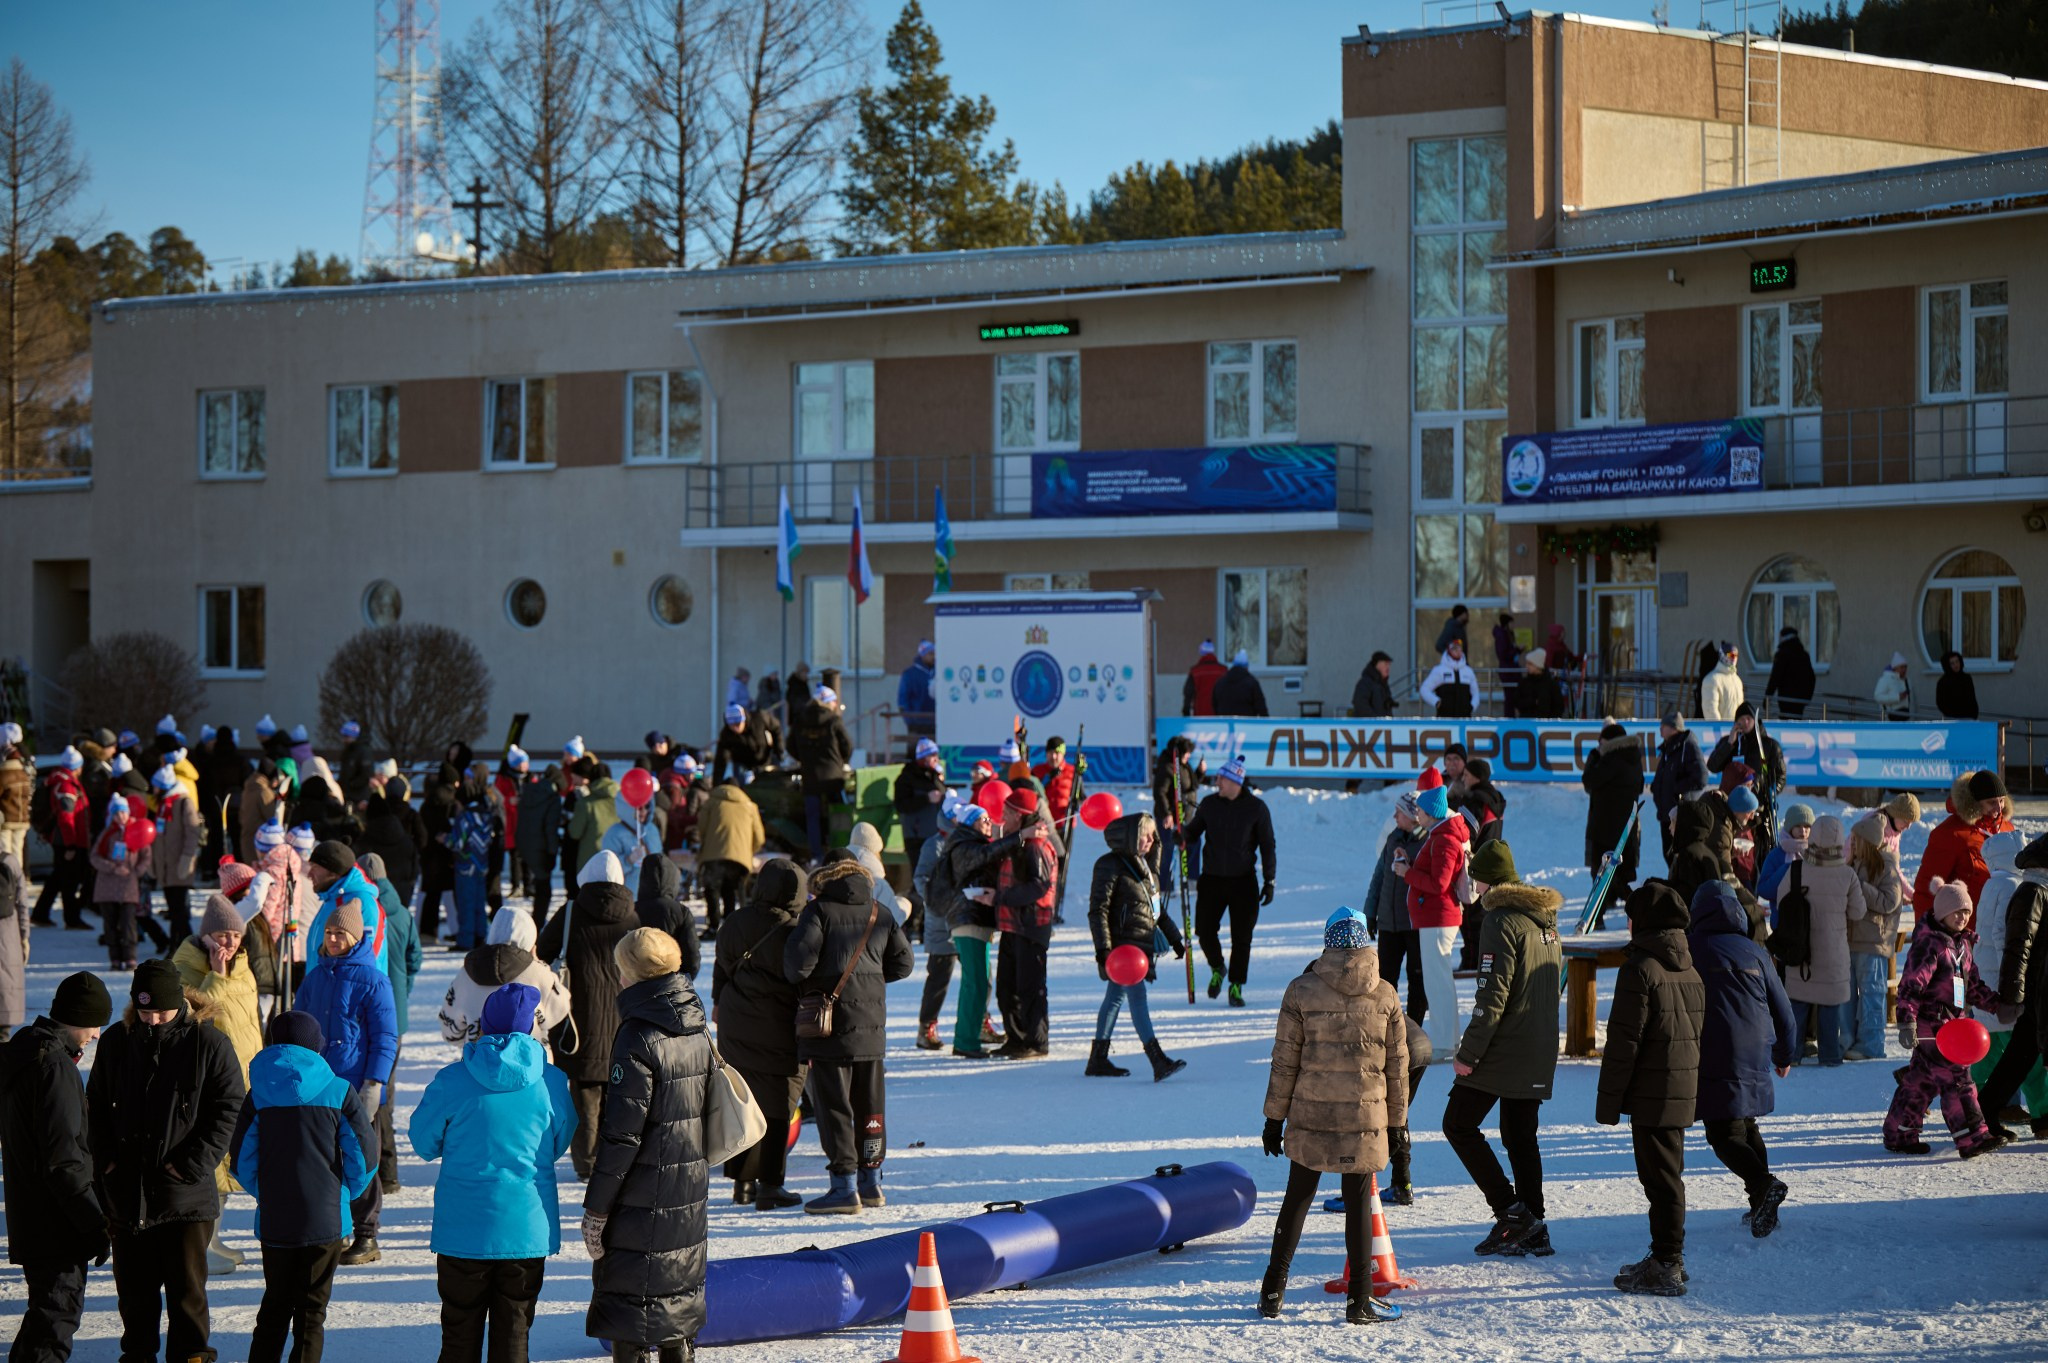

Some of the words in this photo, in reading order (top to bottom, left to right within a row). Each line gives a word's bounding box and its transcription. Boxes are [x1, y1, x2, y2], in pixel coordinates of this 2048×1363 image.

[1602, 467, 1638, 481] ГОНКИ
[1650, 464, 1686, 477] ГОЛЬФ
[1554, 483, 1592, 496] ГРЕБЛЯ
[1595, 482, 1609, 494] НА
[1612, 479, 1675, 493] БАЙДАРКАХ
[1678, 478, 1686, 489] И
[1689, 475, 1726, 488] КАНОЭ
[1265, 728, 1453, 769] ЛЫЖНЯ
[1702, 731, 1859, 776] 26
